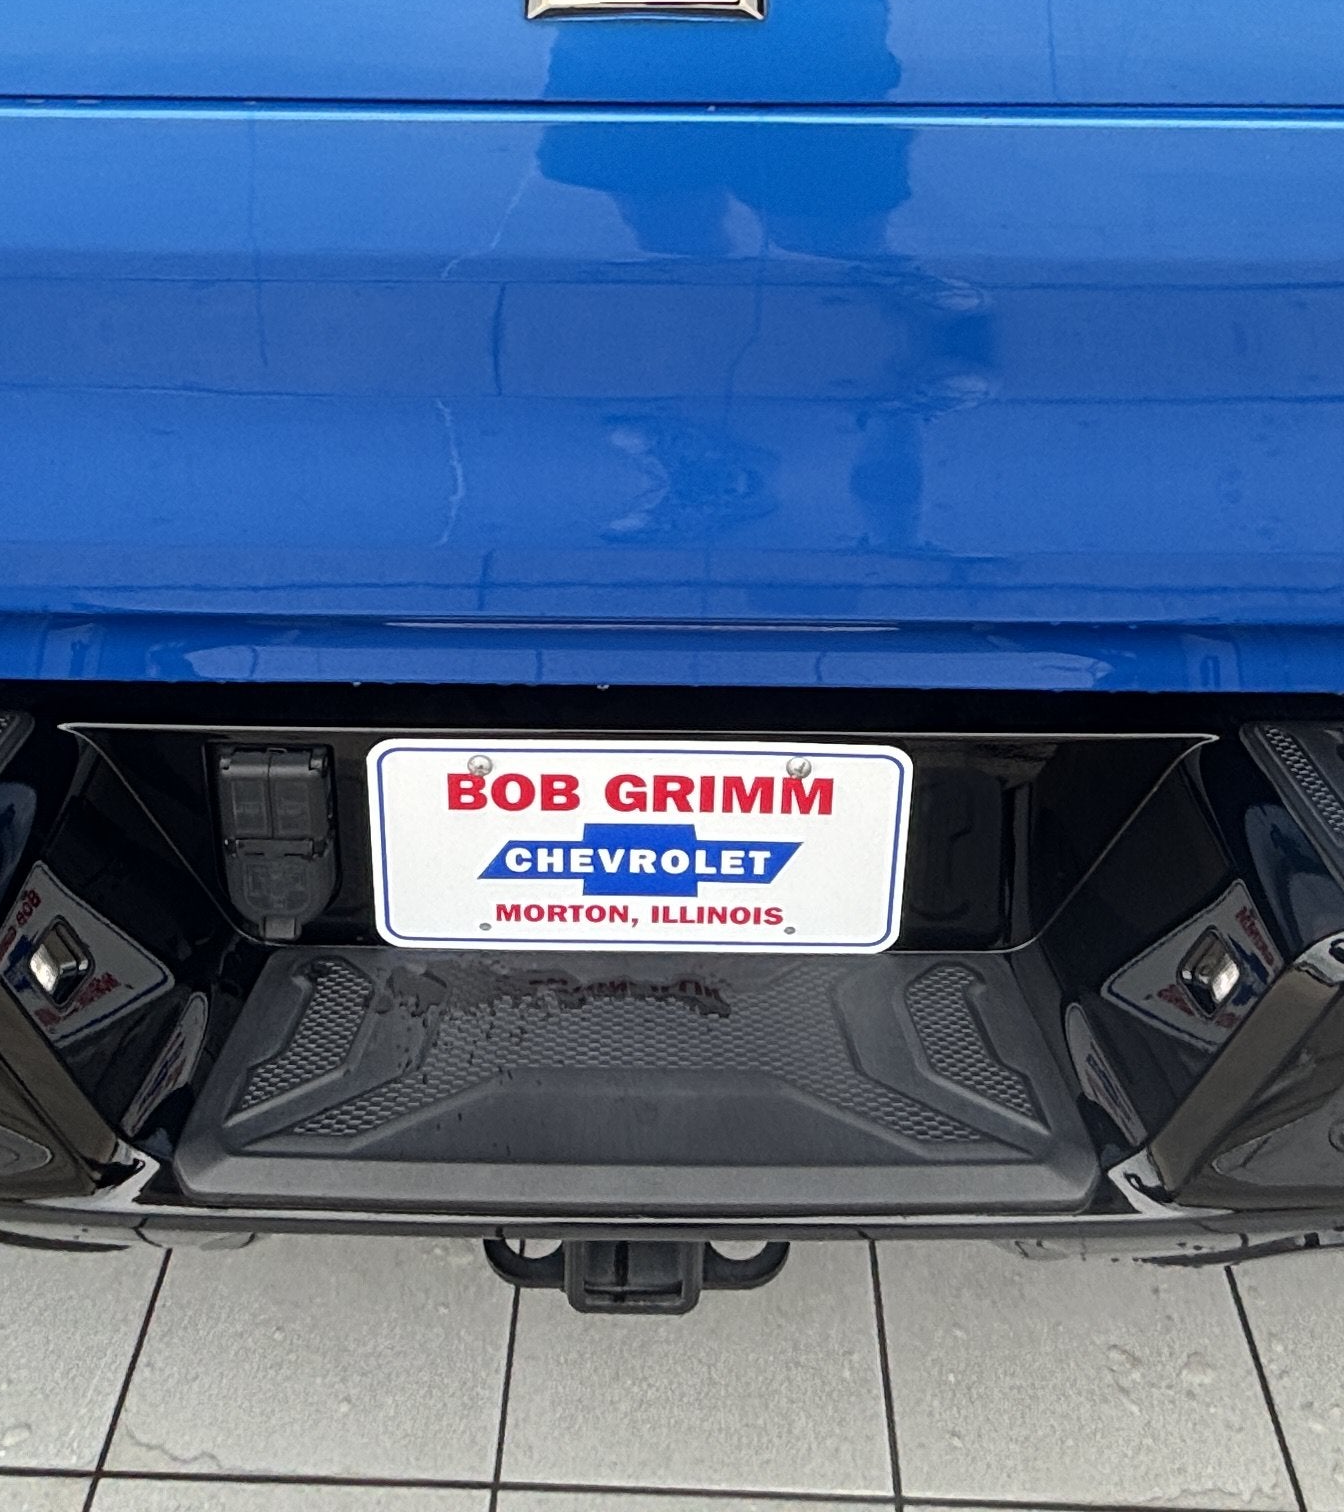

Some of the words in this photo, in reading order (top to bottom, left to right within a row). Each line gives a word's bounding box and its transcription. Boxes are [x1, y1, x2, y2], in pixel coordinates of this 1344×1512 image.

[447, 772, 581, 813] BOB
[605, 774, 835, 816] GRIMM
[503, 845, 772, 876] CHEVROLET
[494, 902, 640, 928] MORTON,
[650, 904, 784, 926] ILLINOIS
